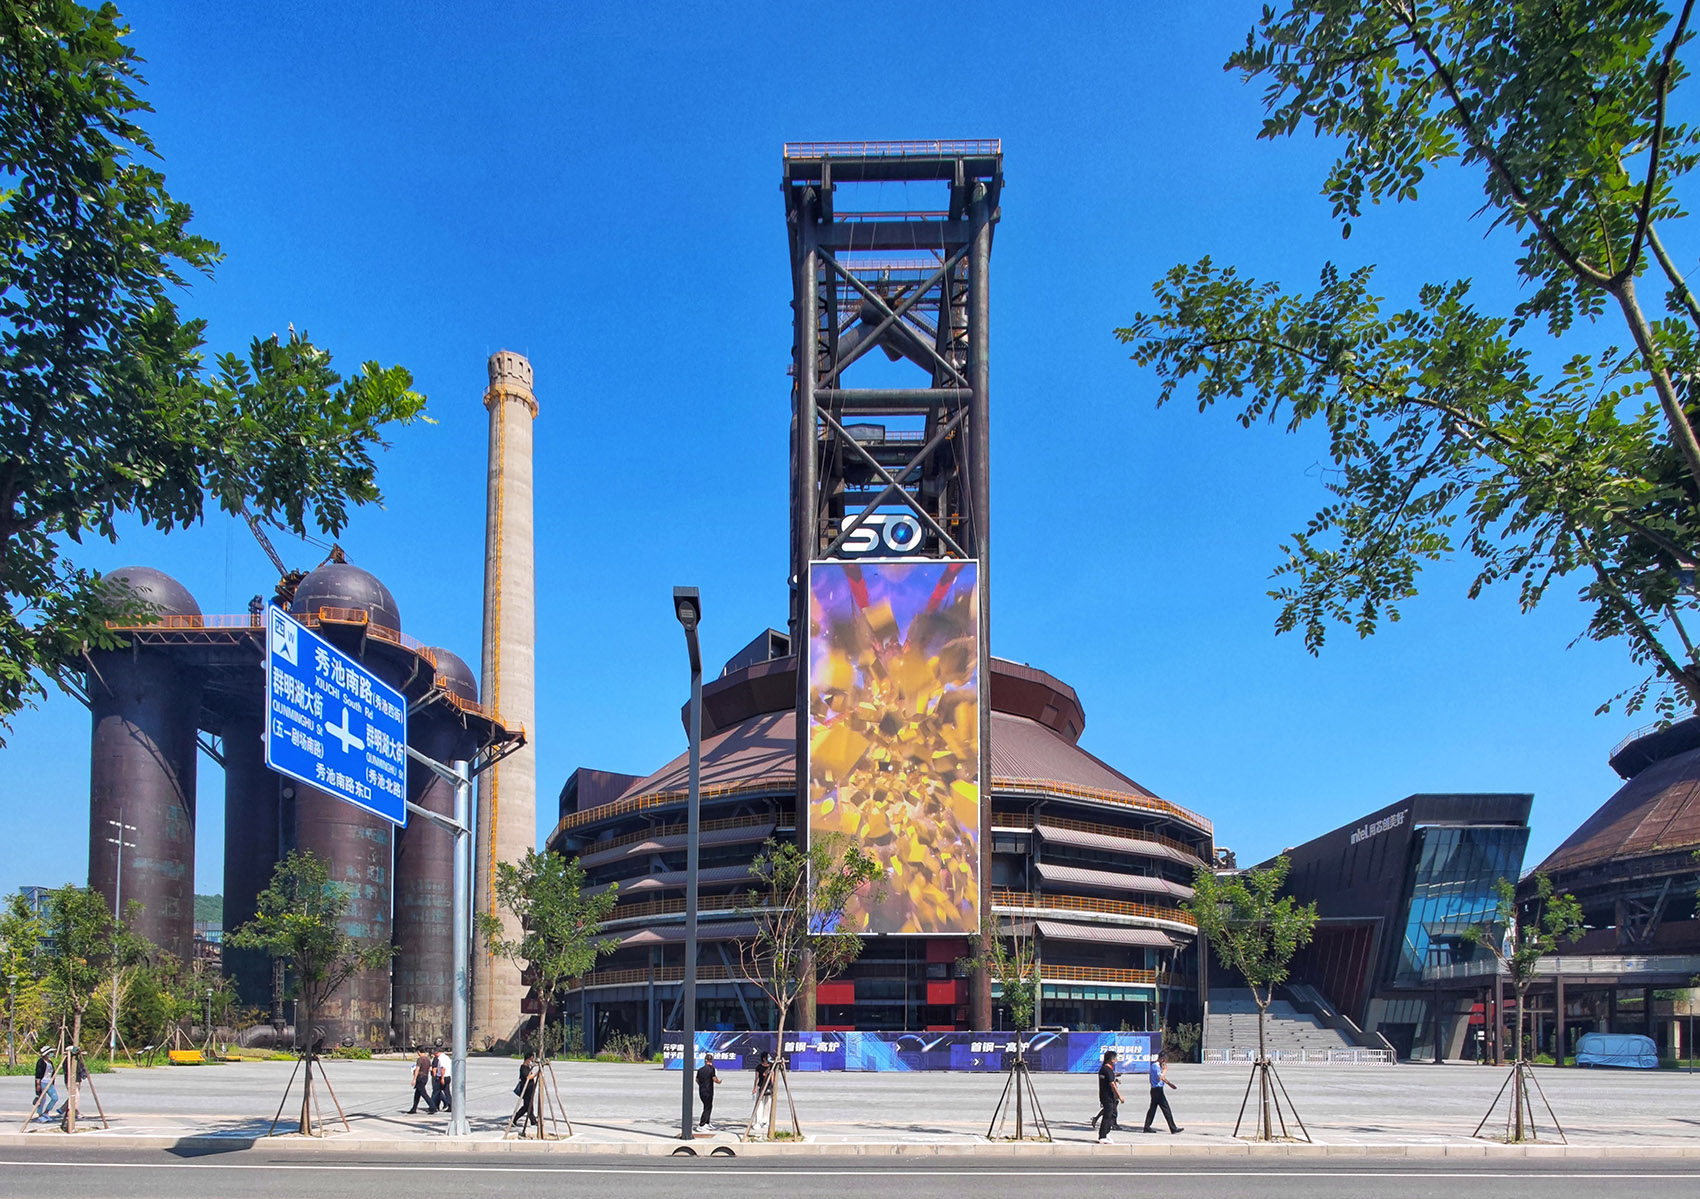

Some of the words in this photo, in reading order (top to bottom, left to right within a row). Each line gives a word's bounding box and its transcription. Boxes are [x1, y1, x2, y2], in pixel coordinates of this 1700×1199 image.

[841, 515, 923, 552] SO
[274, 614, 286, 638] 西
[287, 630, 295, 644] W
[273, 666, 323, 720] 群明湖大街
[315, 675, 340, 700] XIUCHI
[343, 693, 362, 713] South
[365, 706, 373, 720] Rd
[273, 699, 314, 732] QUNMINGHU
[316, 723, 323, 737] St
[366, 722, 403, 765] 群明湖大街
[316, 762, 371, 801] 秀池南路东口
[366, 752, 397, 776] QUNMINGHU
[398, 769, 404, 780] St
[366, 766, 403, 800] (秀池北路)
[784, 1042, 840, 1052] 首钢一高炉
